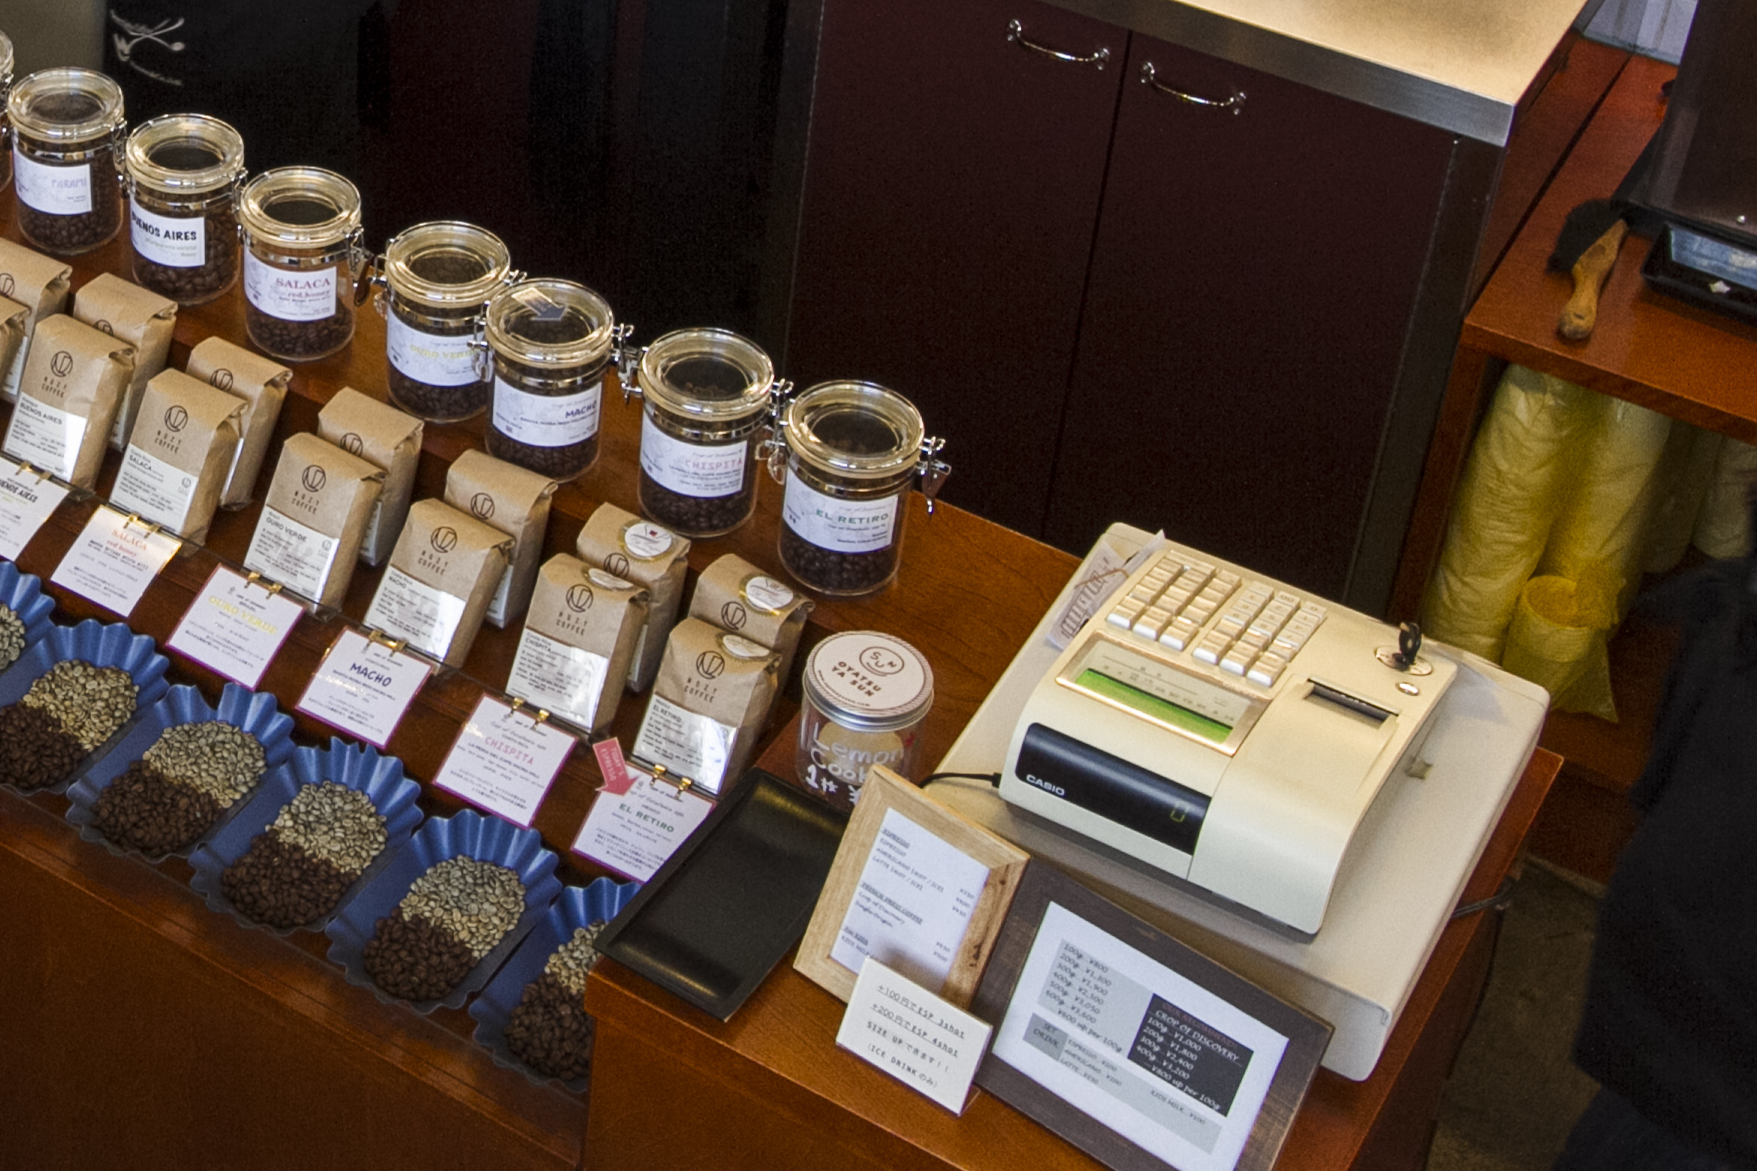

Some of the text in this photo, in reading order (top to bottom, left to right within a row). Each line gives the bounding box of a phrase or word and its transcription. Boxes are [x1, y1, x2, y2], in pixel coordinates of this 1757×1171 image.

[163, 230, 197, 241] AIRES
[277, 278, 331, 290] SALACA
[41, 383, 65, 399] COFFEE
[20, 402, 62, 425] BUENOS AIRES
[565, 400, 597, 419] MACHO
[154, 437, 179, 454] COFFEE
[129, 454, 152, 472] SALACA
[684, 457, 743, 471] CHISPITA
[18, 487, 39, 504] AIRES
[291, 498, 317, 515] COFFEE
[816, 509, 889, 524] EL RETIRO
[266, 517, 308, 543] OURO VERDE
[111, 528, 148, 552] SALACA
[418, 558, 446, 576] COFFEE
[208, 595, 278, 636] OURO VERDE
[555, 618, 586, 637] COFFEE
[525, 637, 552, 653] CHISPITA
[869, 651, 897, 669] SUN
[349, 662, 393, 688] MACHO
[831, 666, 874, 697] YA SUN
[837, 661, 882, 692] OYATSU
[684, 685, 715, 704] COFFEE
[652, 703, 682, 724] EL RETIRO
[484, 736, 534, 765] CHISPITA
[1026, 774, 1065, 796] CASIO
[619, 803, 675, 833] EL RETIRO
[880, 838, 906, 857] ESPRESSO
[901, 908, 923, 925] COFFEE
[867, 1020, 888, 1037] SIZE
[1143, 1026, 1164, 1043] 200g
[1147, 1017, 1168, 1034] 100g
[1033, 1028, 1059, 1048] DRINK
[1155, 1010, 1239, 1061] CROP OF DISCOVERY
[932, 1037, 958, 1057] 4shot
[1183, 1084, 1200, 1097] per
[1199, 1094, 1221, 1111] 100g
